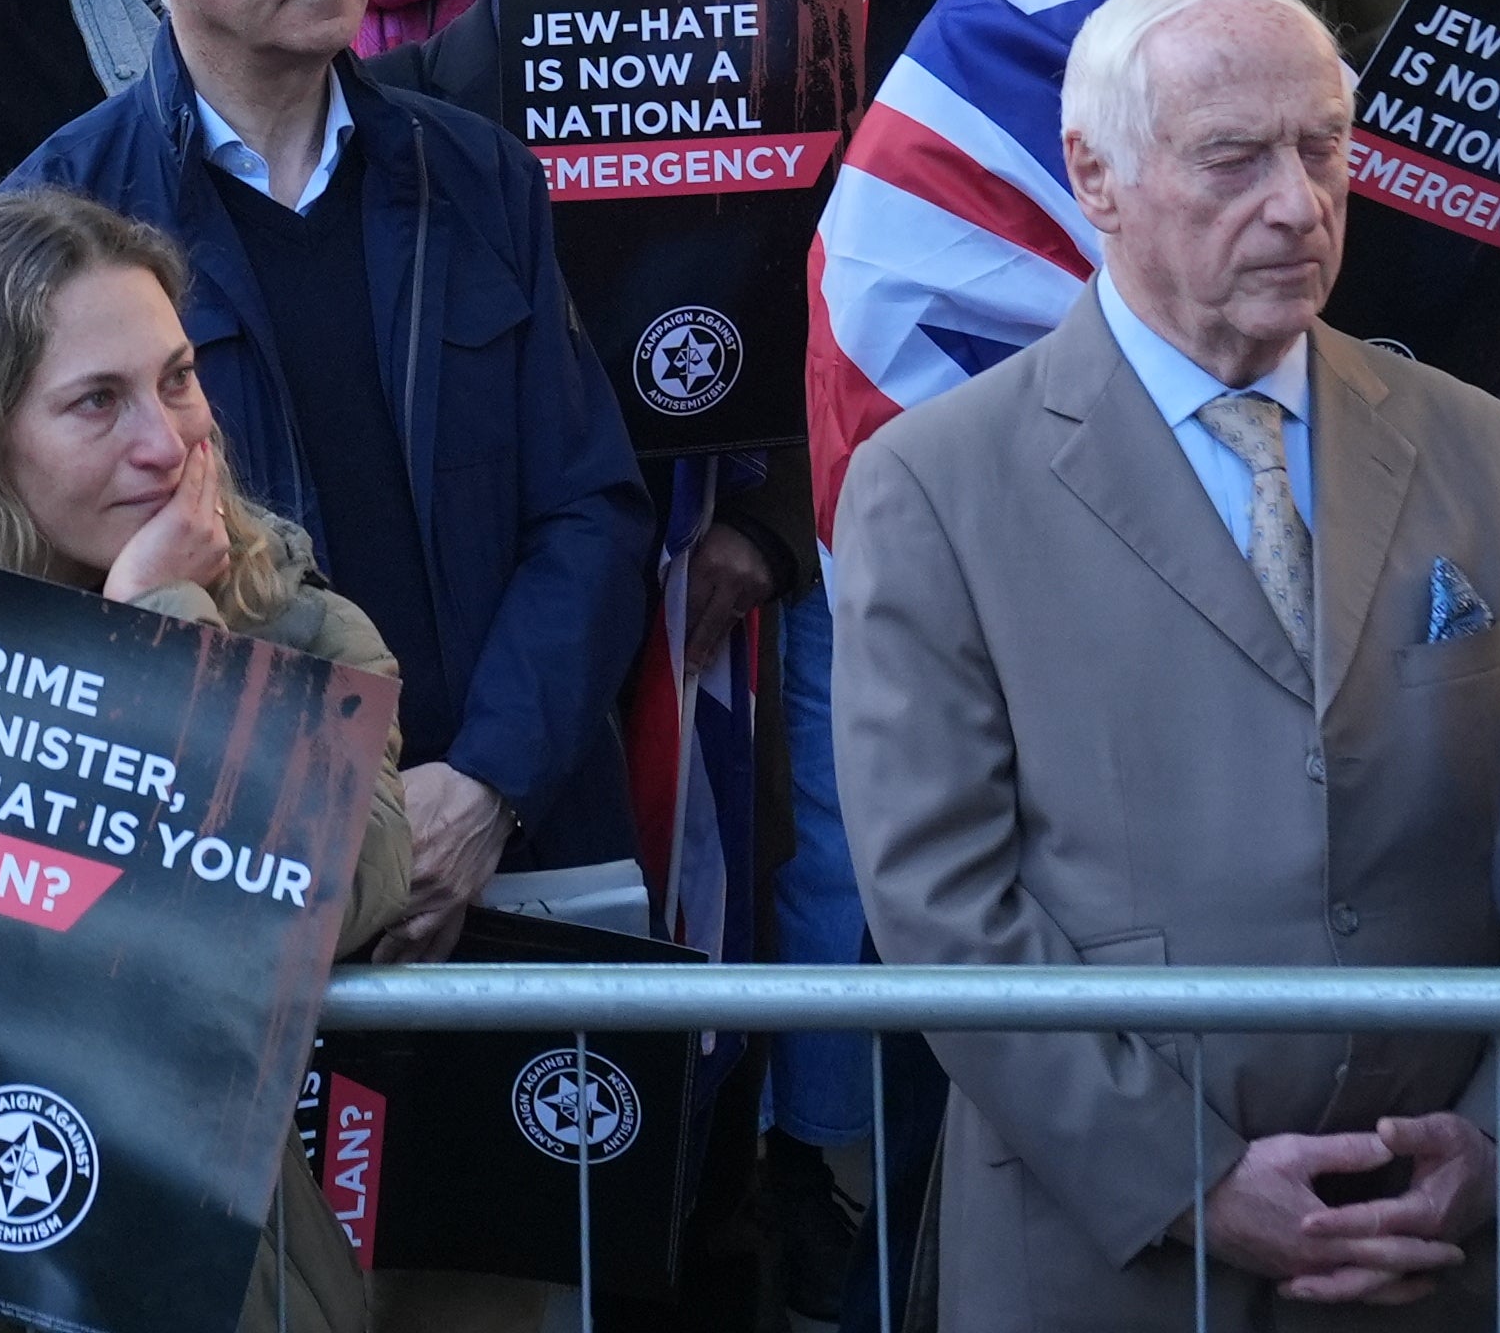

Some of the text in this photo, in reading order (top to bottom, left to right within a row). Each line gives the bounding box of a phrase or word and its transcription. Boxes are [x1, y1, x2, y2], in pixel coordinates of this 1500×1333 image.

[521, 3, 759, 48] JEW-HATE
[524, 51, 740, 93] IS NOW A
[1390, 47, 1430, 87] IS
[526, 97, 763, 140] NATIONAL
[640, 312, 737, 360] CAMPAIGN AGAINST
[646, 380, 727, 411] ANTISEMITISM
[86, 804, 139, 856] IS
[157, 819, 313, 907] YOUR
[520, 1054, 573, 1155] CAMPAIGN AGAINST
[602, 1071, 635, 1155] ANTISEMITISM
[44, 1100, 91, 1179] AGAINST
